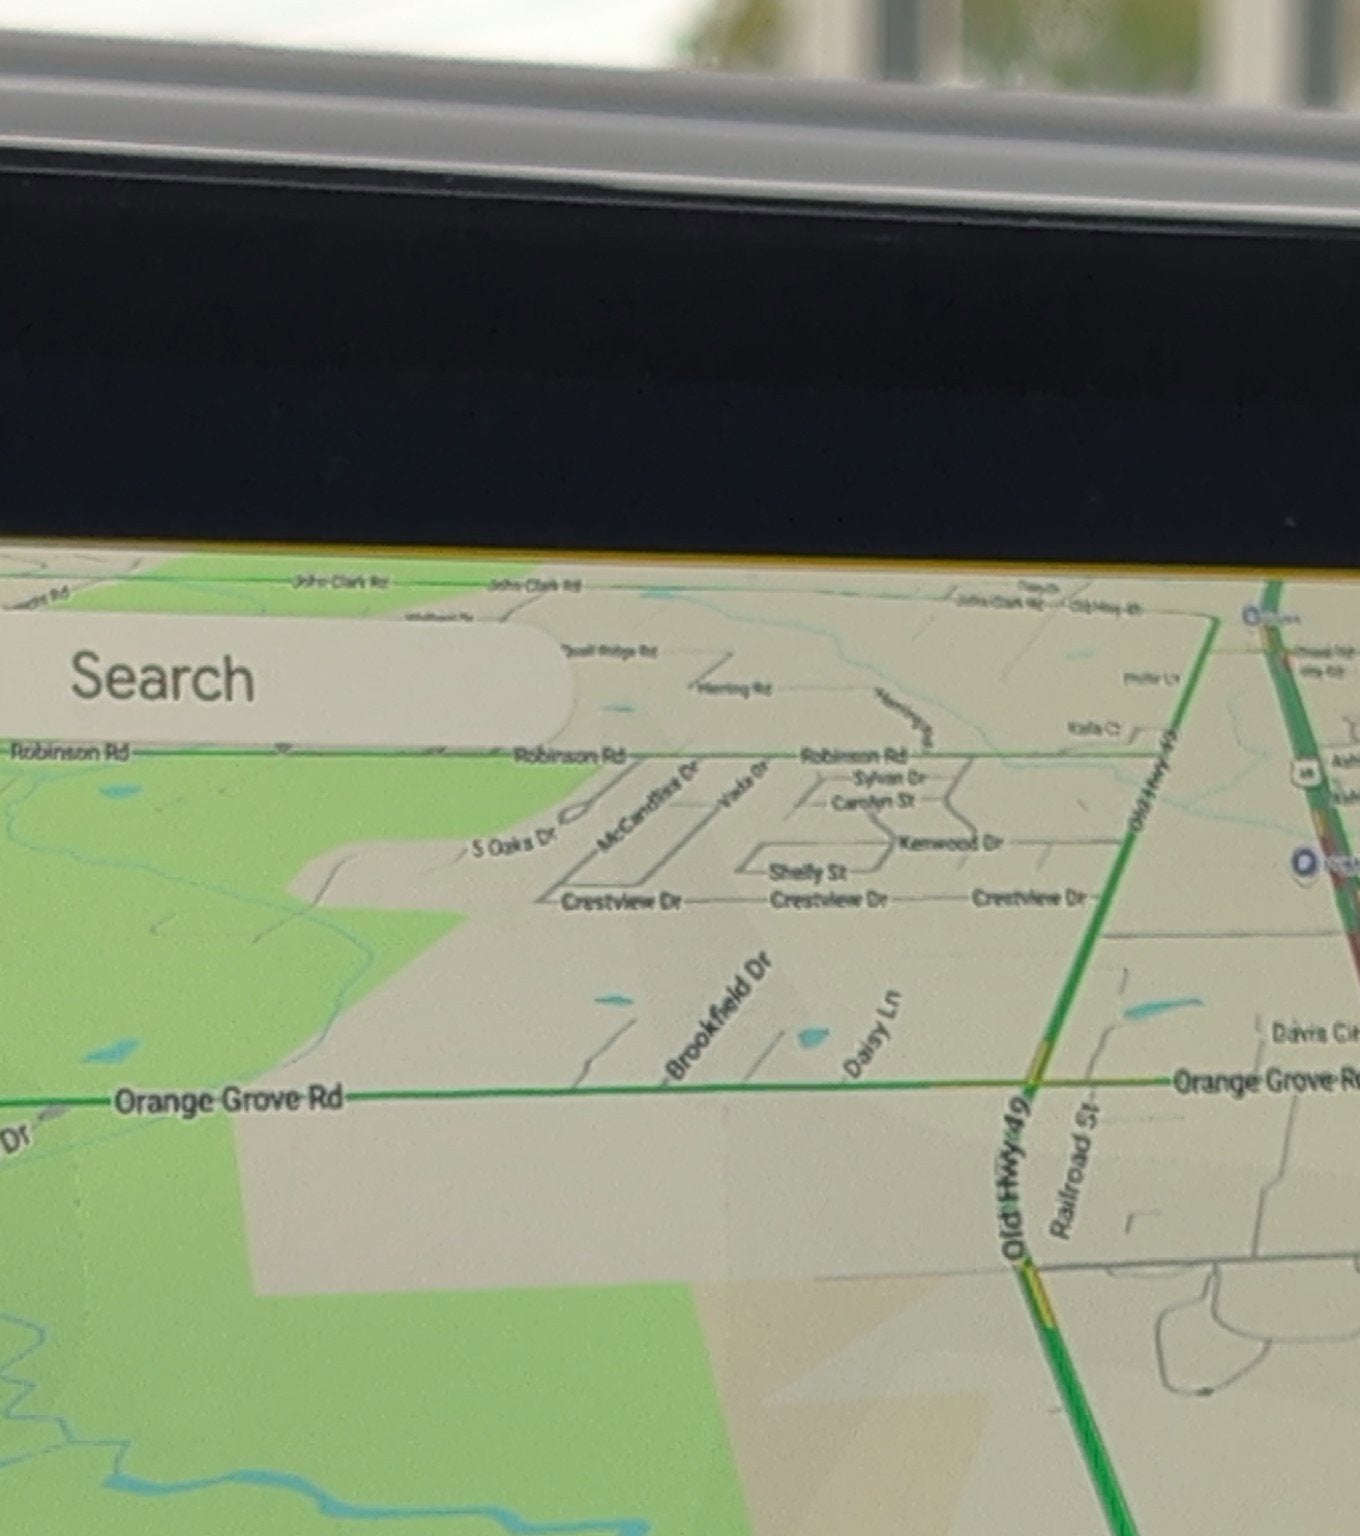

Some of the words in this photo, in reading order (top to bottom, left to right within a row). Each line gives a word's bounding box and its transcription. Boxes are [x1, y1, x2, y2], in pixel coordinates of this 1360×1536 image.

[71, 649, 255, 703] Search
[10, 741, 101, 763] Robinson
[105, 742, 130, 763] Rd
[513, 744, 598, 766] Robinson
[601, 745, 627, 766] Rd
[800, 745, 880, 766] Robinson
[884, 746, 908, 766] Rd
[472, 839, 484, 859] S
[487, 833, 532, 858] Oaks
[528, 825, 557, 848] Dr
[897, 834, 973, 854] Kenwood
[976, 834, 1004, 853] Dr
[769, 862, 824, 886] Shelly
[826, 862, 849, 882] St
[561, 891, 656, 911] Crestview
[659, 890, 683, 911] Dr
[770, 889, 864, 910] Crestview
[866, 889, 889, 909] Dr
[972, 887, 1060, 908] Crestview
[1064, 888, 1087, 908] Dr
[663, 973, 751, 1084] Brookfield
[746, 949, 774, 983] Dr
[1273, 1020, 1328, 1044] Davis
[842, 1017, 892, 1081] Daisy
[882, 987, 903, 1018] Ln
[1173, 1068, 1261, 1100] Orange
[1265, 1068, 1334, 1092] Grove
[114, 1087, 215, 1119] Orange
[222, 1086, 301, 1112] Grove
[310, 1082, 344, 1110] Rd
[1004, 1094, 1033, 1129] 49
[0, 1122, 33, 1155] Dr
[995, 1130, 1029, 1209] Hwy
[1048, 1133, 1094, 1241] Railroad
[1076, 1101, 1100, 1130] St
[1001, 1209, 1027, 1262] Old
